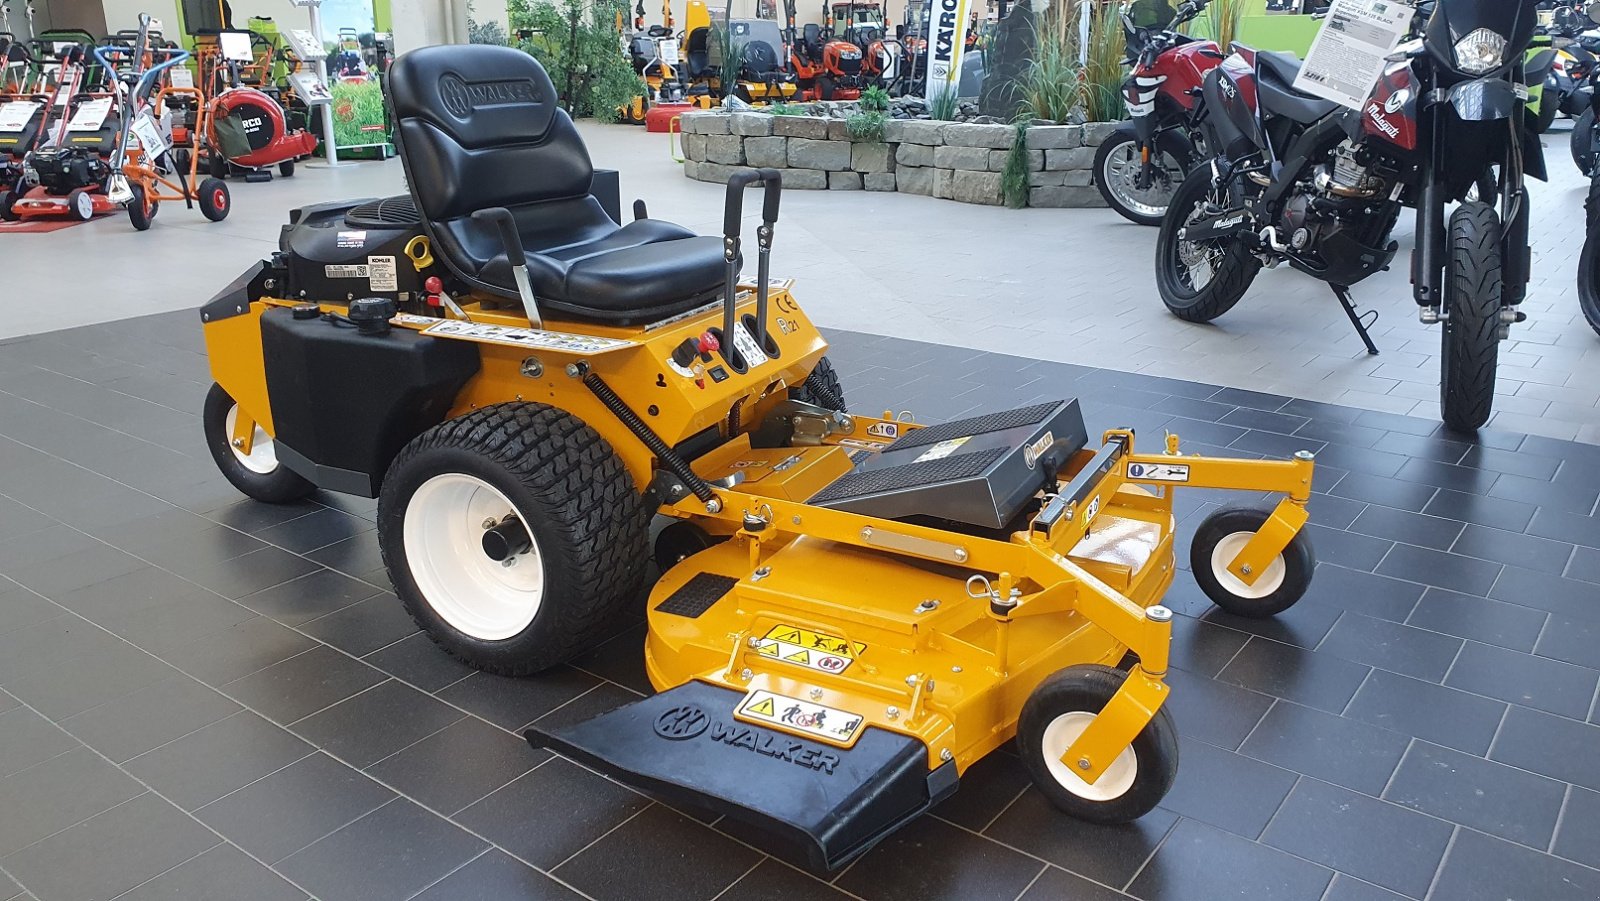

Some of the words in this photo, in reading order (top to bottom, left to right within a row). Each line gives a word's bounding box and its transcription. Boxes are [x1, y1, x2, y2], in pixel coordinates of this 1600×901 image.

[468, 84, 540, 101] WALKER
[1367, 103, 1399, 138] Malaguti
[710, 720, 840, 775] WALKER
